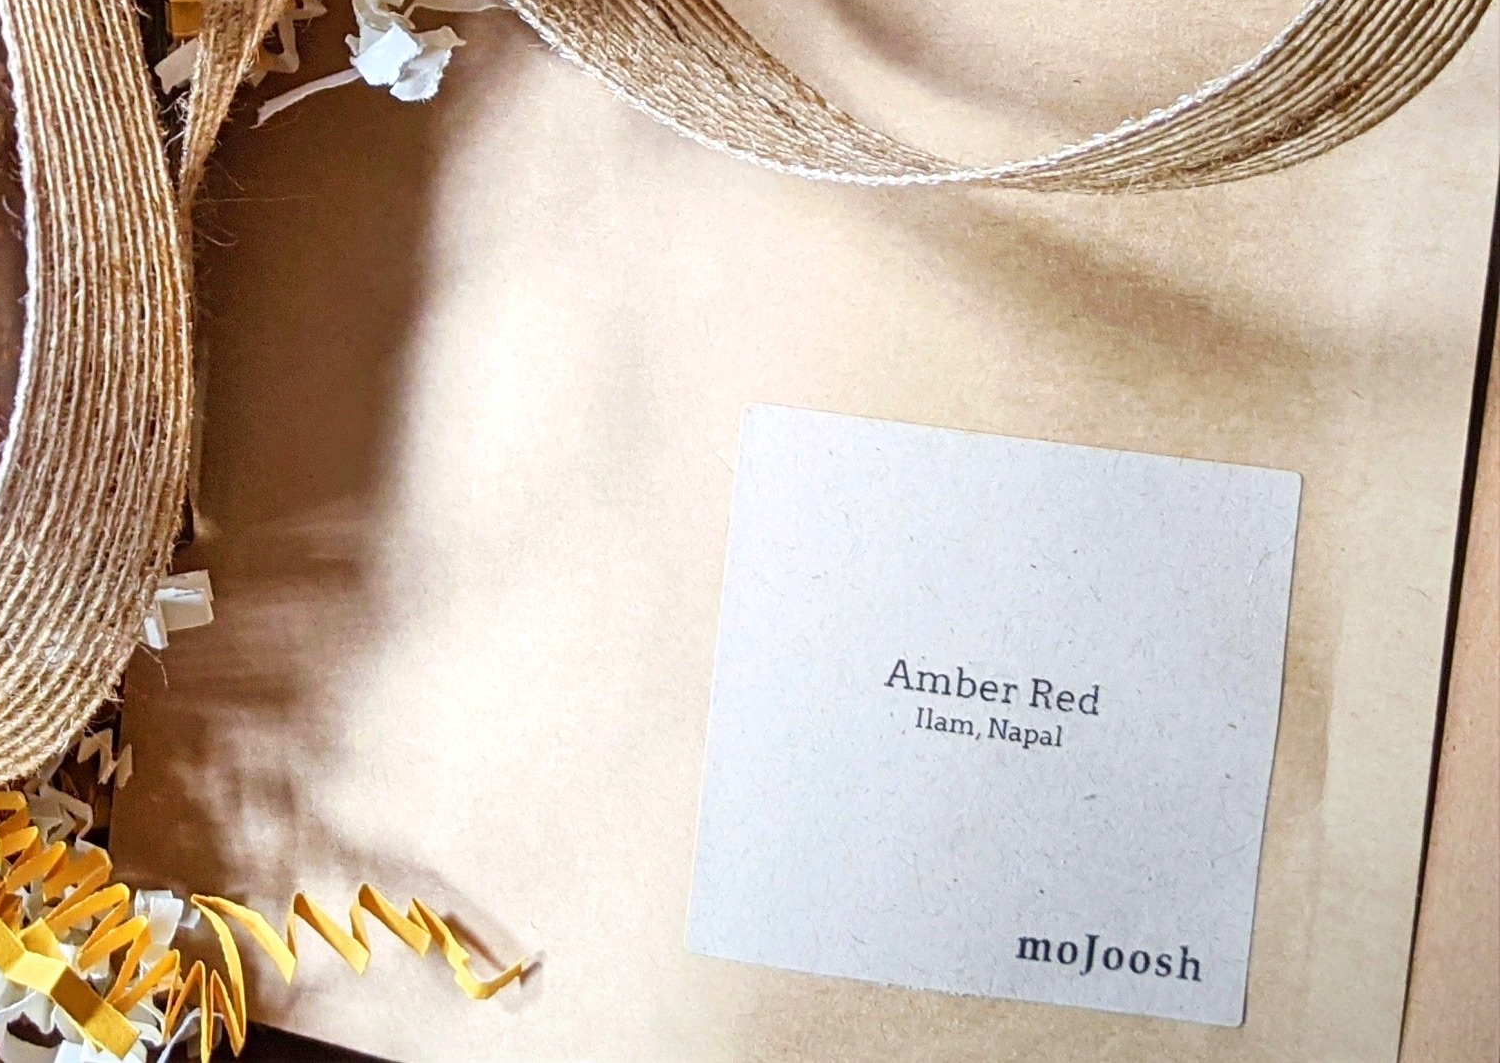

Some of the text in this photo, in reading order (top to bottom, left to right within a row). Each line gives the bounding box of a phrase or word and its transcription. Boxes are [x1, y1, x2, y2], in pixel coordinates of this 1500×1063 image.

[883, 658, 1102, 716] Amber Red
[915, 707, 1064, 750] Ilam, Napal
[1015, 934, 1203, 983] moJoosh
